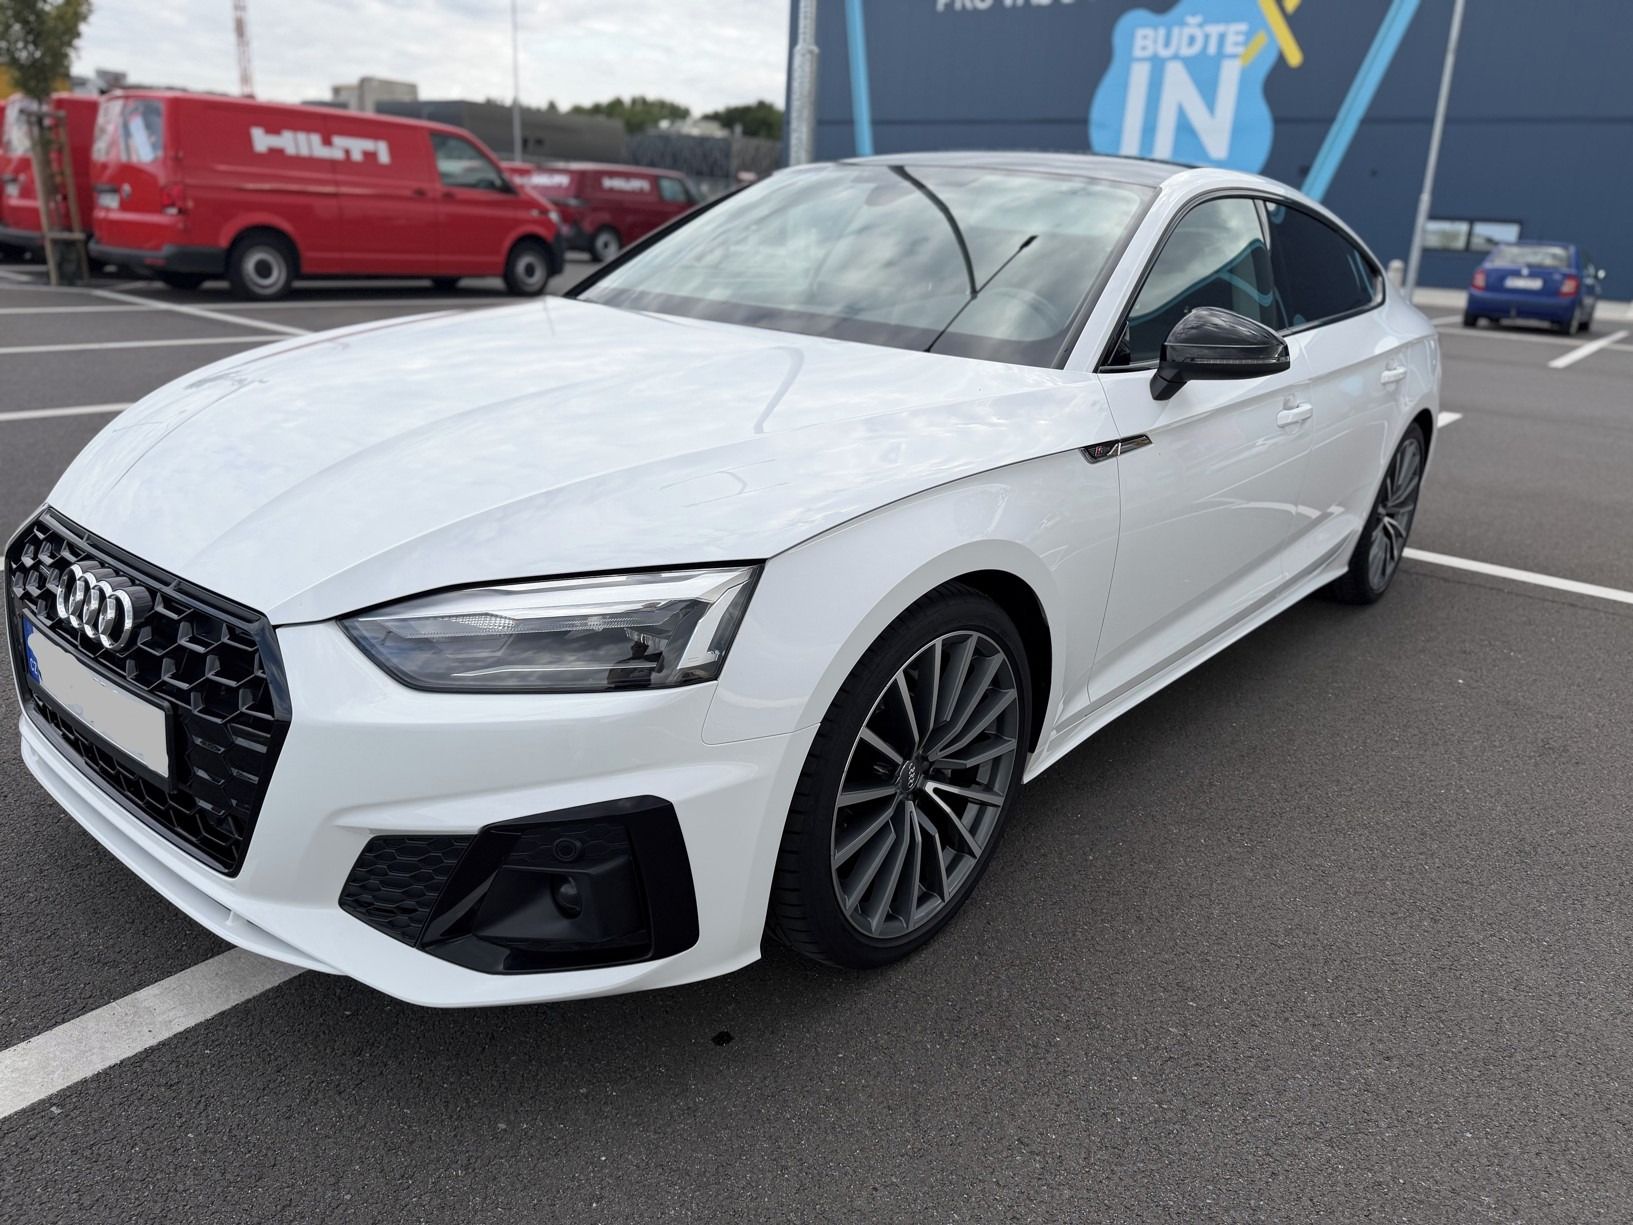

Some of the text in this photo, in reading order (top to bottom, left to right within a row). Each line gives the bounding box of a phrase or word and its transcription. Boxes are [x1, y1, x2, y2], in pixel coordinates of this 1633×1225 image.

[1132, 16, 1249, 59] BUĎTE
[1118, 57, 1242, 161] IN
[250, 126, 392, 165] HILTI
